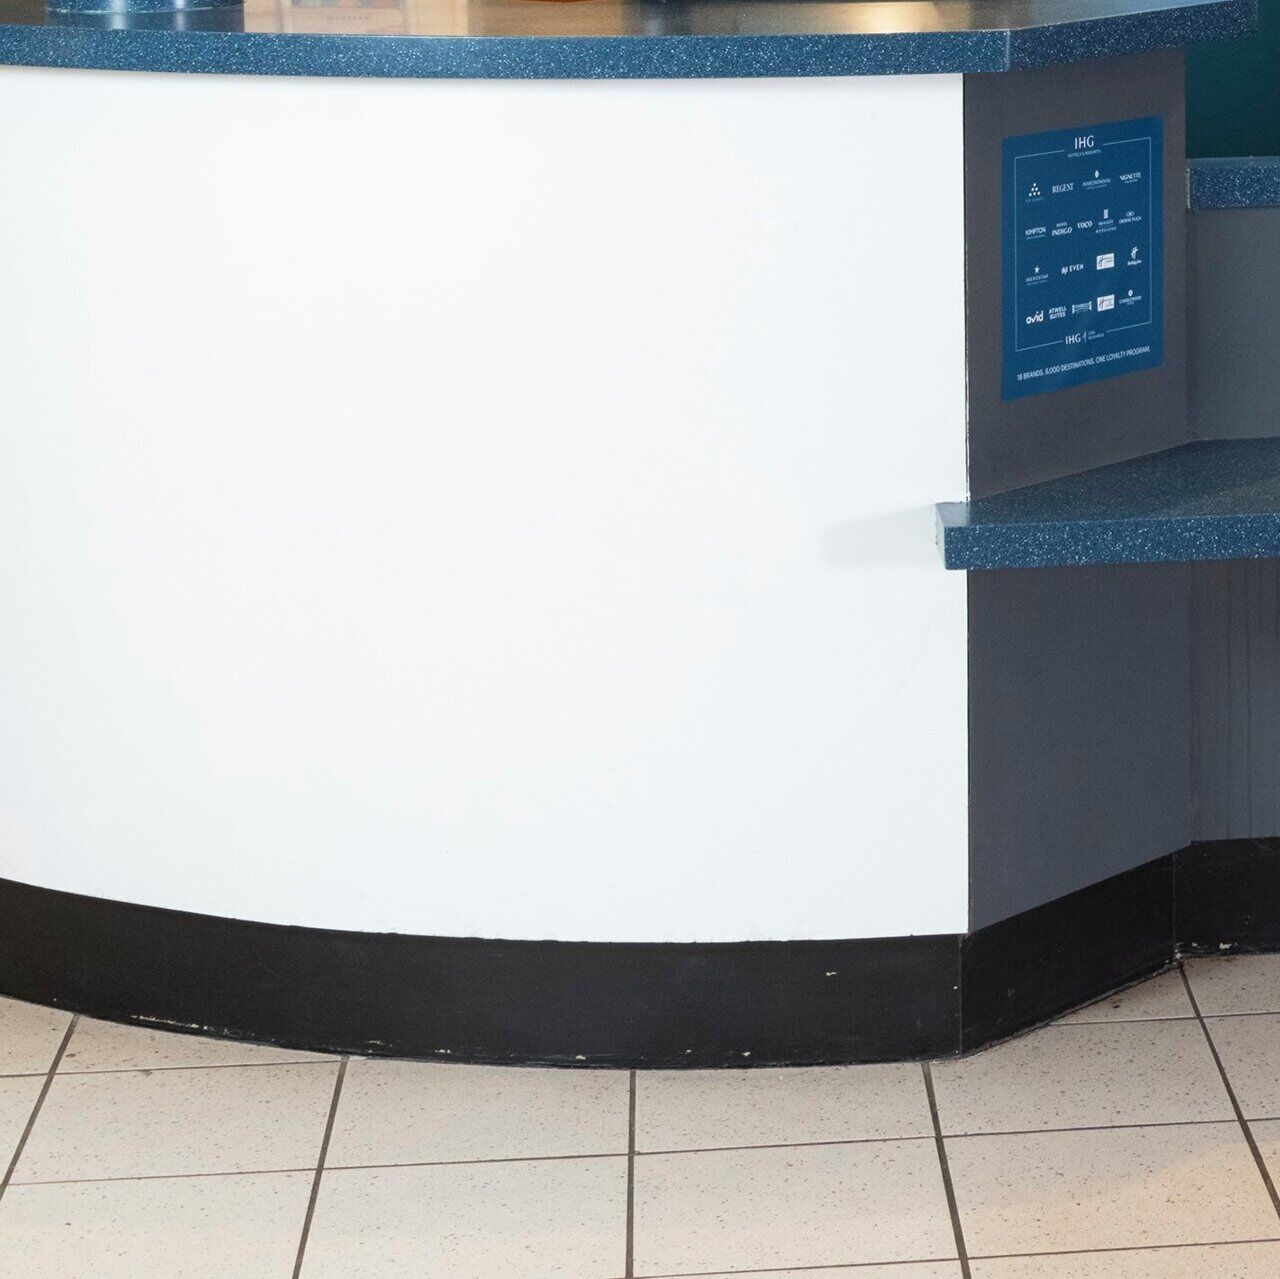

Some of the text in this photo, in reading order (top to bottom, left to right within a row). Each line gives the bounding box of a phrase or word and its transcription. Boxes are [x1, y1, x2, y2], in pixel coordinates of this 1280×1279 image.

[1074, 135, 1094, 149] IHG
[1052, 183, 1074, 194] REGENT
[1025, 227, 1046, 236] KIMPTON
[1052, 227, 1072, 236] INDIGO
[1069, 264, 1084, 272] EVEN
[1049, 306, 1066, 314] ATWELL
[1026, 310, 1044, 325] avid
[1066, 334, 1081, 345] IHG
[1023, 371, 1044, 380] BRANDS.
[1045, 366, 1060, 375] 6,000
[1060, 357, 1095, 373] DESTINATIONS.
[1096, 356, 1106, 364] ONE
[1106, 351, 1126, 362] LOYALTY
[1126, 346, 1150, 357] PROGRAM.
